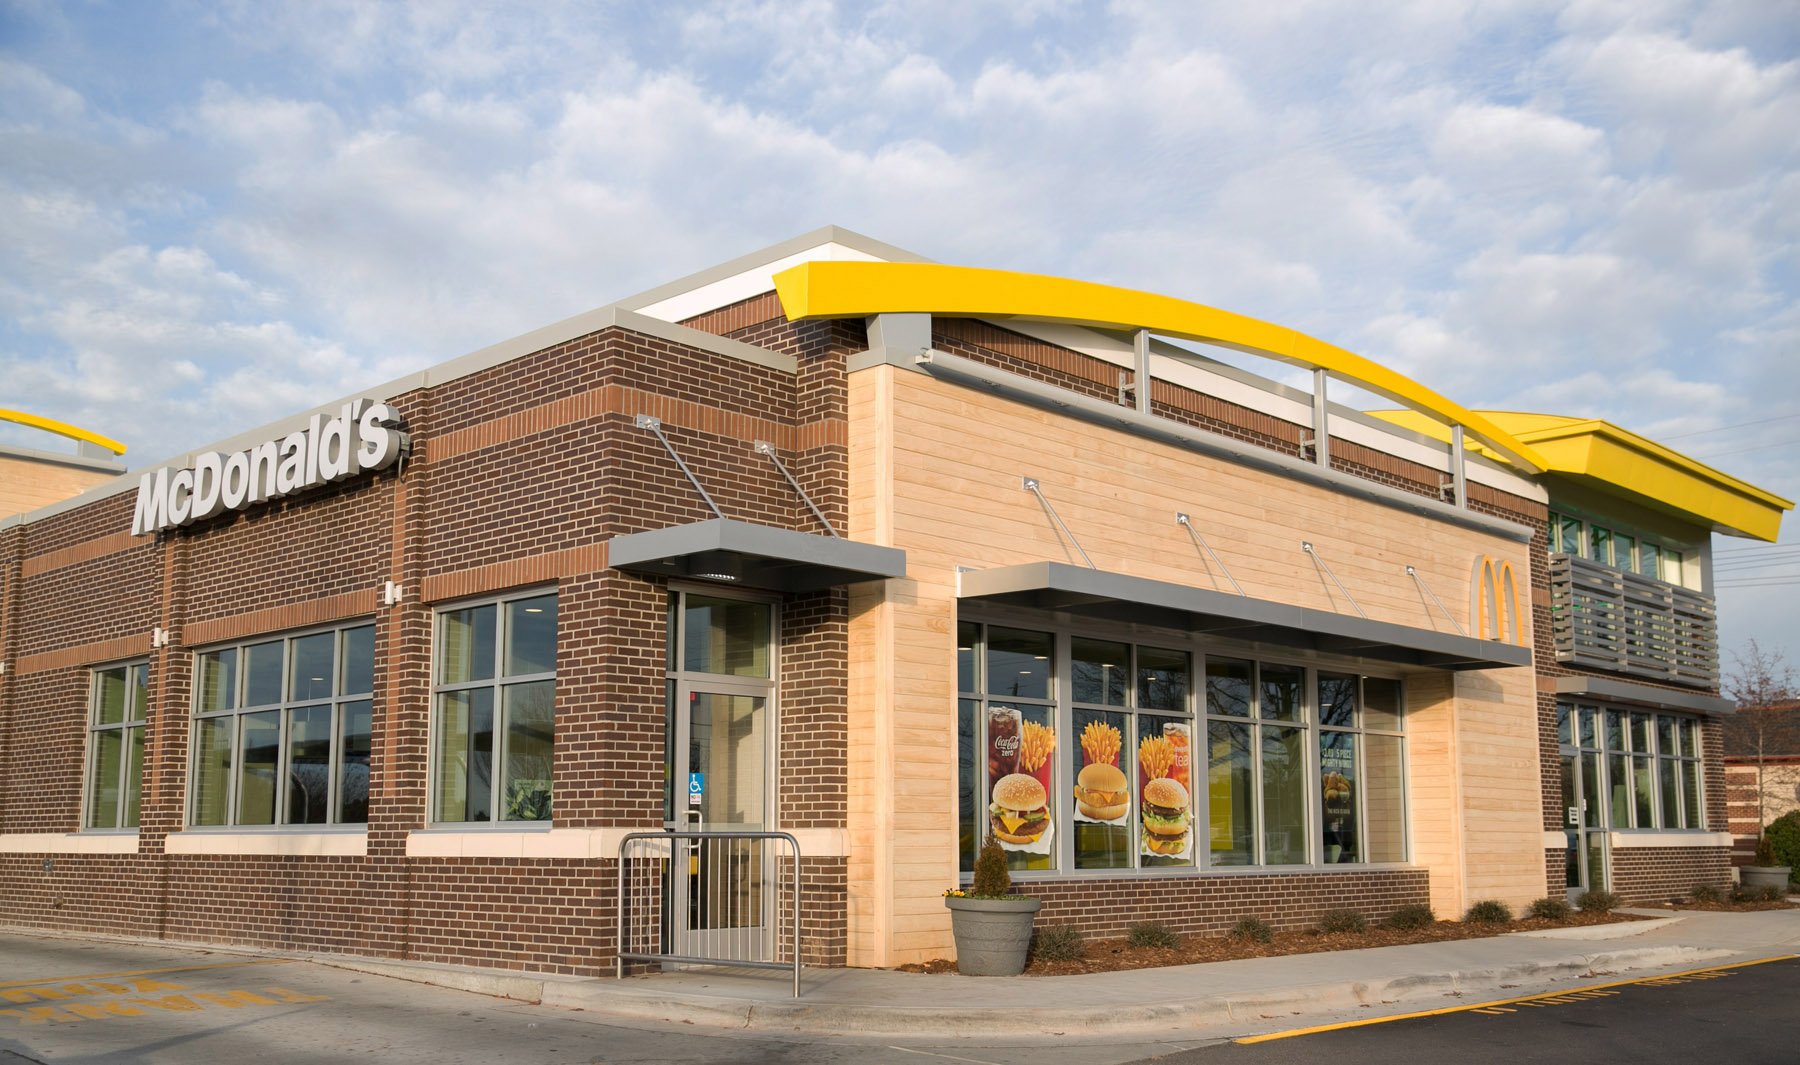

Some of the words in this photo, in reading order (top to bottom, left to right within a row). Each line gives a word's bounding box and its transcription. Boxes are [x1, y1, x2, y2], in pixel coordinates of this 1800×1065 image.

[131, 398, 400, 536] McDonald's
[1174, 752, 1189, 767] tea
[0, 986, 333, 1026] THANK
